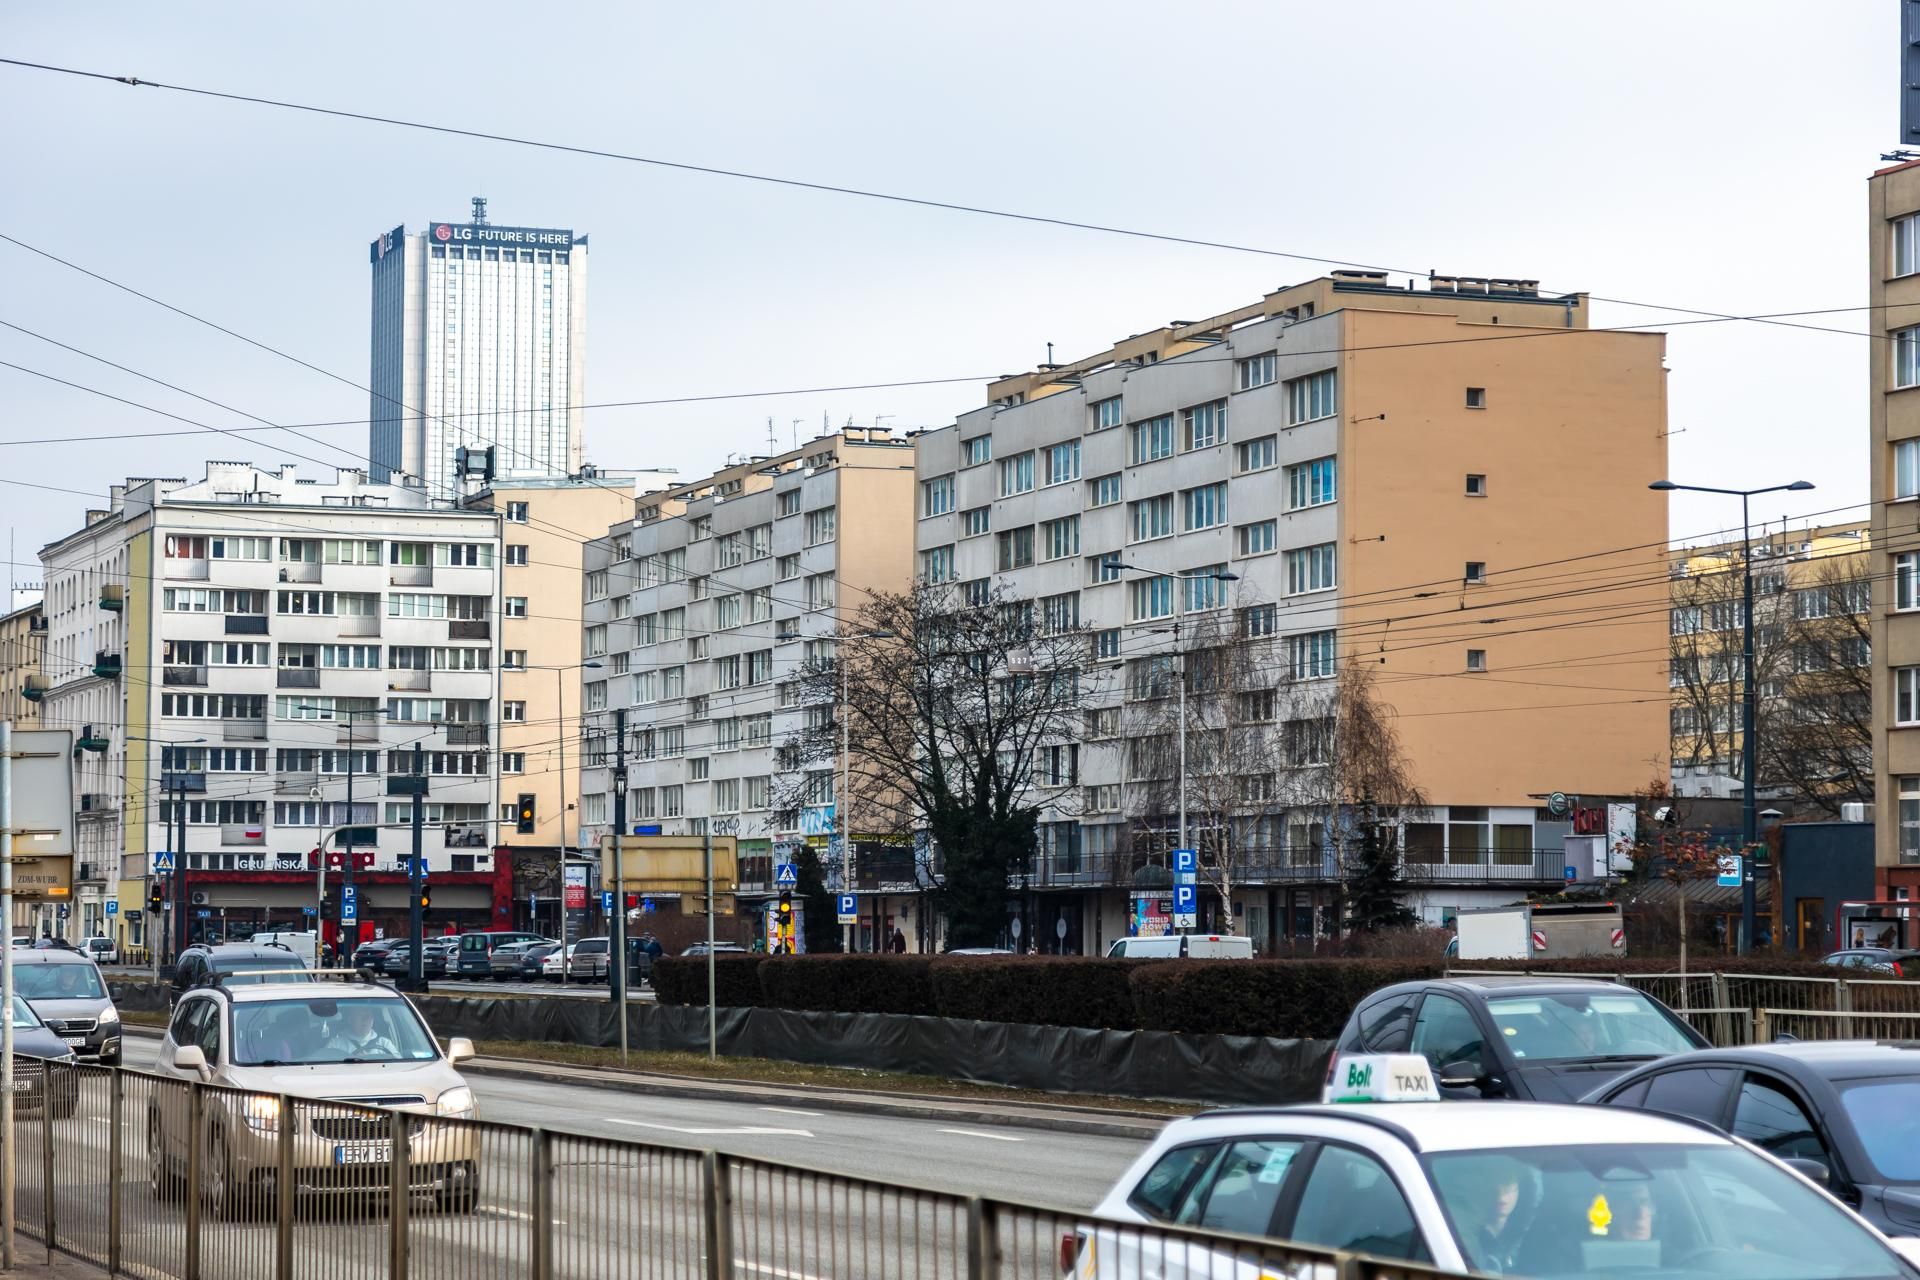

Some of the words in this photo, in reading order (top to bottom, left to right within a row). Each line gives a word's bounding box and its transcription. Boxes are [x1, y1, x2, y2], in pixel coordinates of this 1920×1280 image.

[384, 232, 393, 252] LG
[453, 228, 472, 240] LG
[478, 230, 523, 242] FUTURE
[525, 233, 537, 243] IS
[539, 234, 569, 245] HERE
[1011, 657, 1027, 665] 527
[1178, 852, 1191, 870] P
[345, 887, 354, 899] P
[1178, 887, 1191, 905] P
[108, 902, 116, 912] P
[345, 905, 354, 917] P
[842, 896, 853, 912] P
[1347, 1063, 1373, 1088] Bolt
[1395, 1075, 1428, 1092] TAXI
